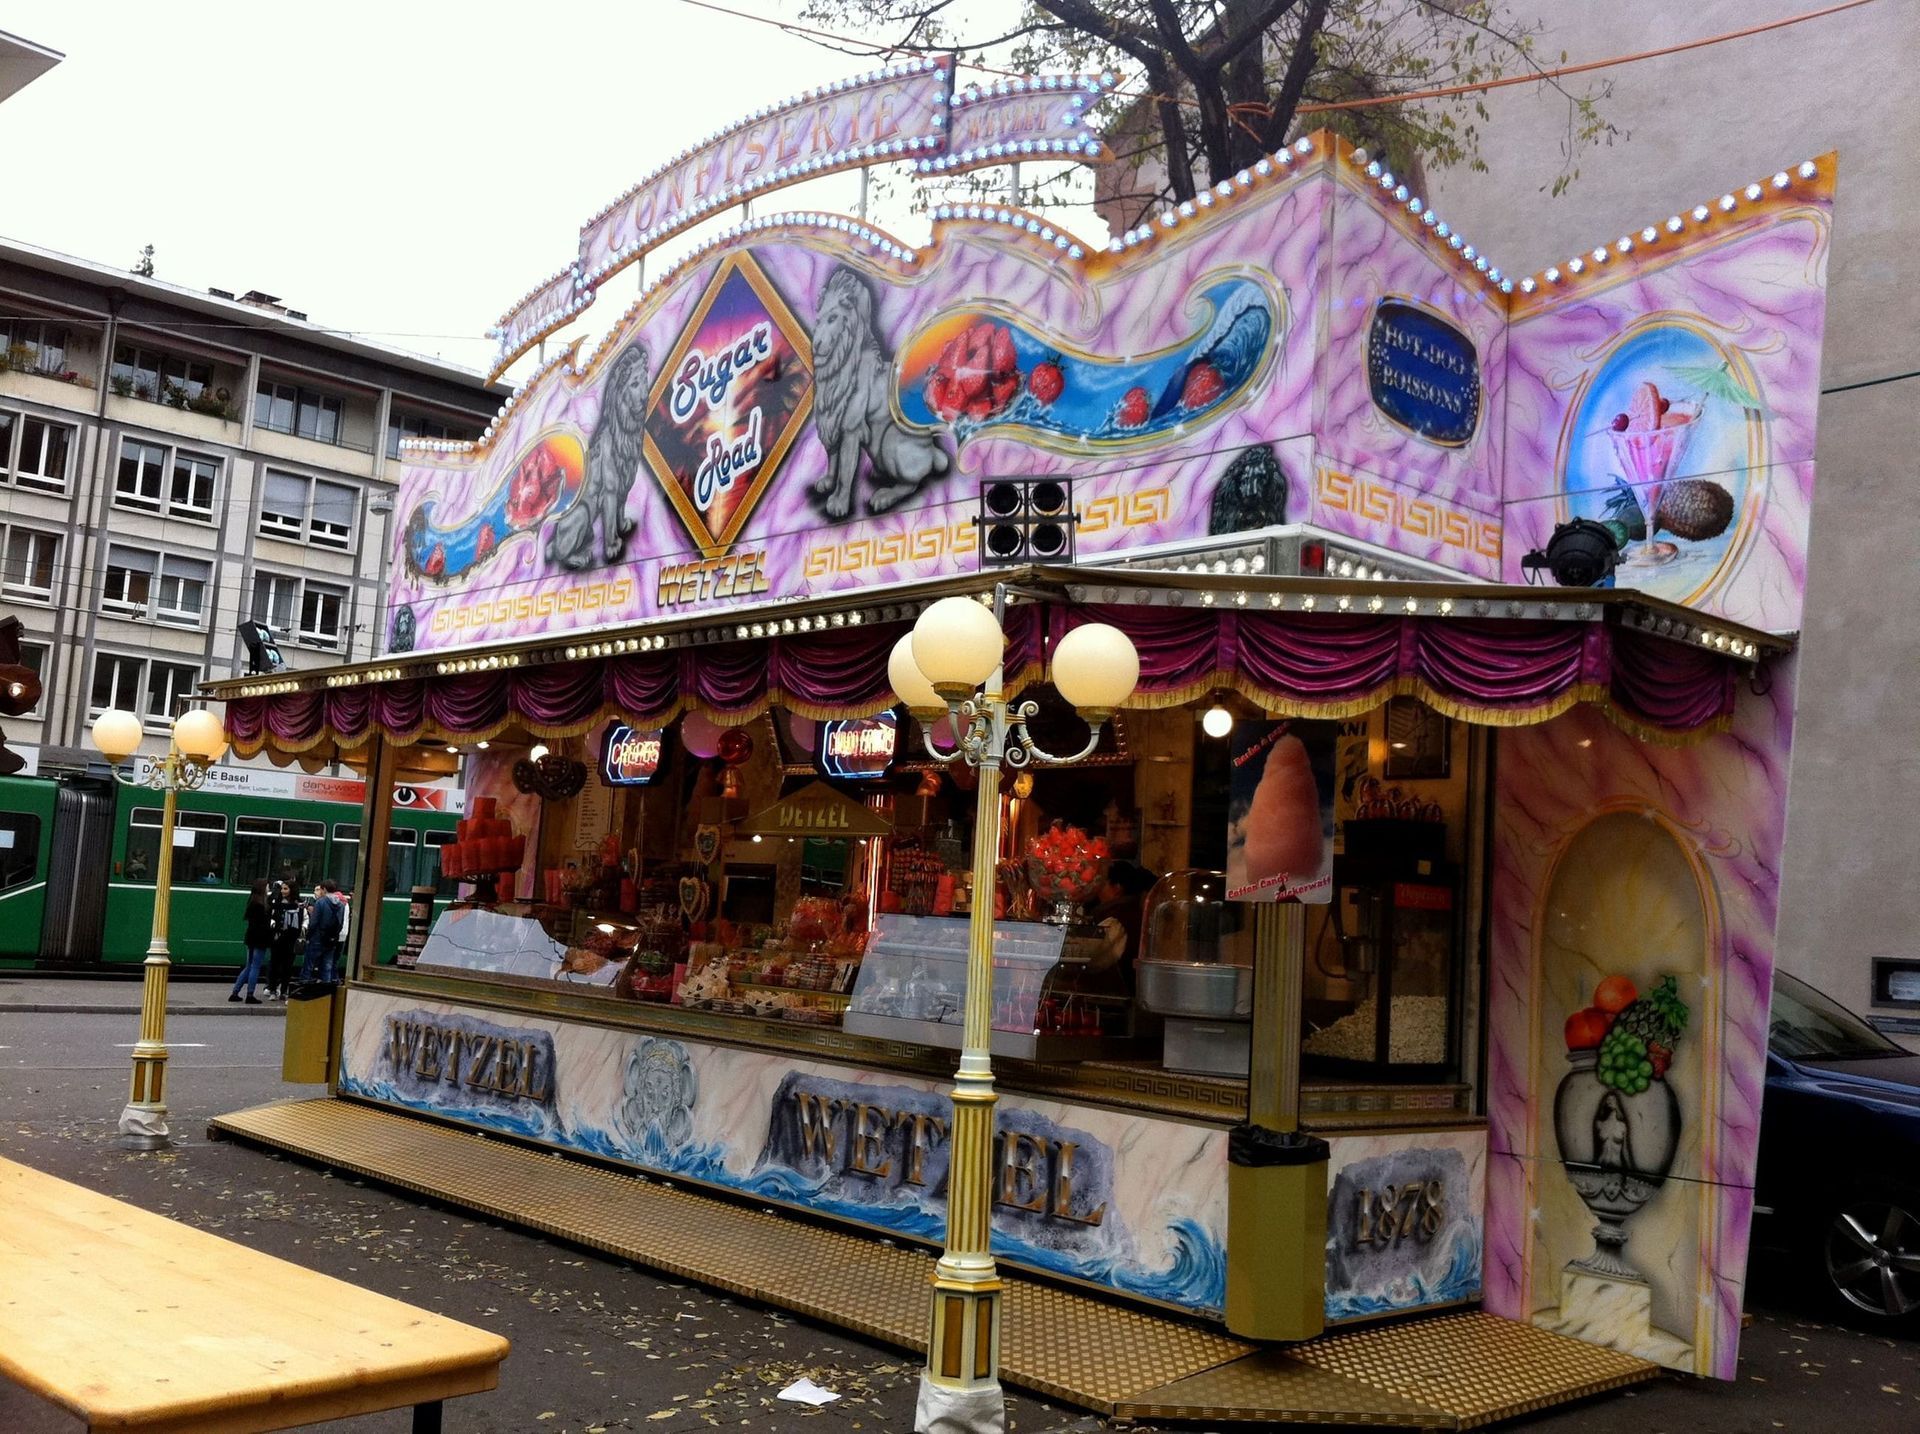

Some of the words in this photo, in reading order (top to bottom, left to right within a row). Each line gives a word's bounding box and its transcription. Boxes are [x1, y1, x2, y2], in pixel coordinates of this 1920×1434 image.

[606, 84, 900, 253] CONFISERIE
[671, 323, 770, 420] Sugar
[1384, 323, 1466, 376] HOT-DOG
[1382, 364, 1463, 415] BOISSONS
[697, 412, 759, 506] Road
[656, 549, 771, 608] WETZEL
[220, 771, 250, 783] Basel
[388, 1017, 548, 1100] WETZEL
[793, 1091, 1106, 1228] WETEL
[1356, 1179, 1444, 1246] 1878
